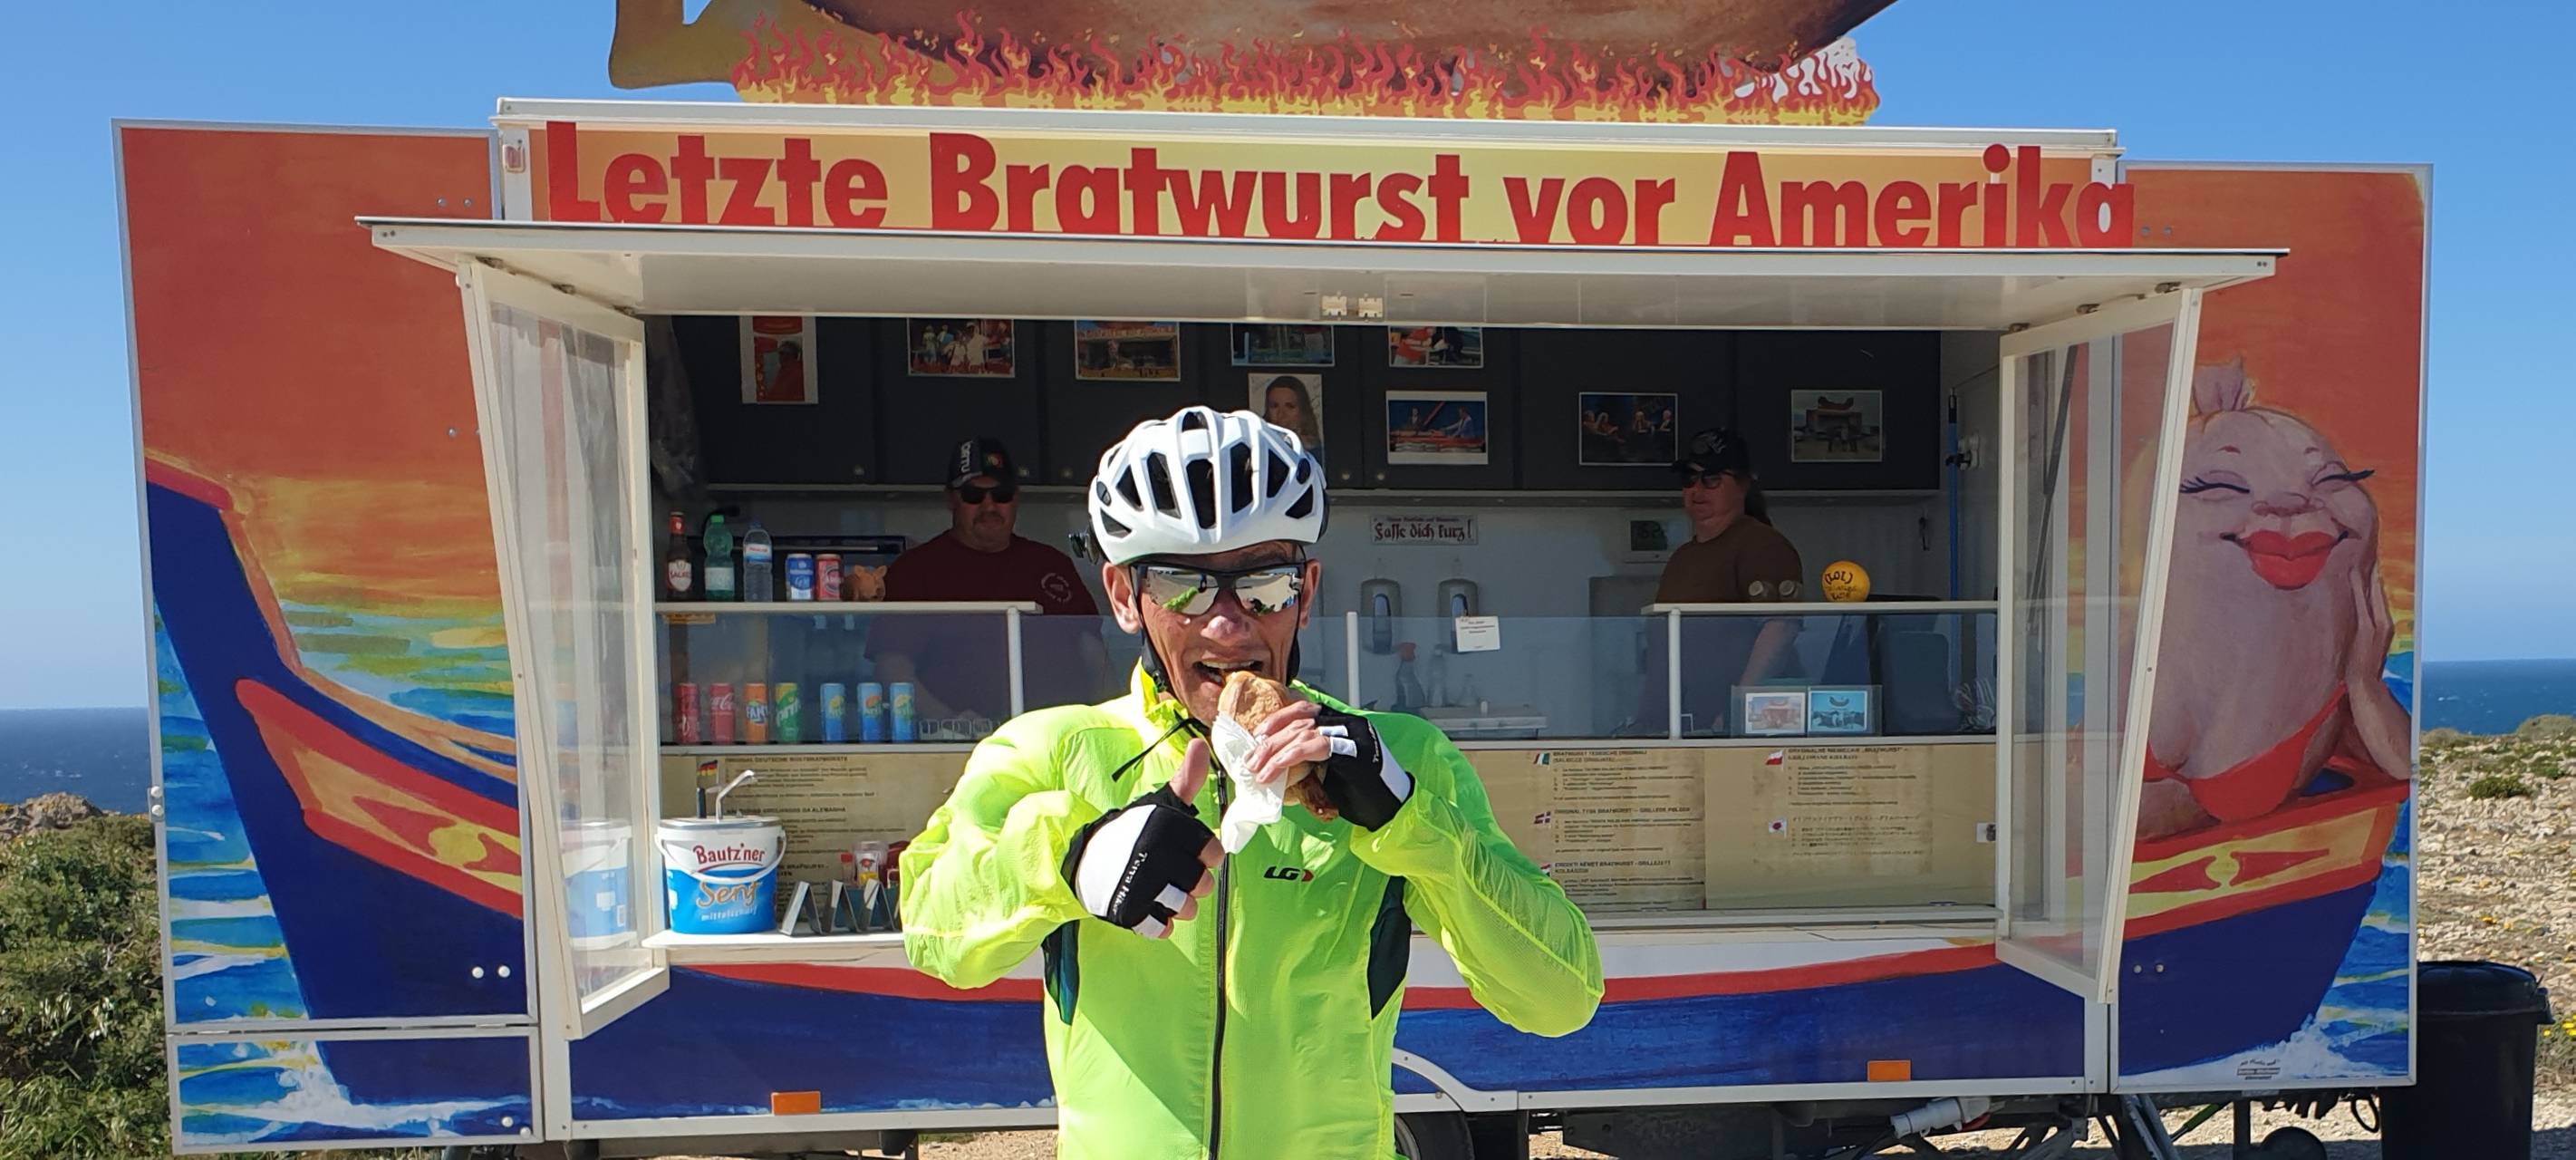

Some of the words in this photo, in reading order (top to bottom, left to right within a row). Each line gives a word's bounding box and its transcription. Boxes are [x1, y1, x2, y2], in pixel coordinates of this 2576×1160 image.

[546, 121, 888, 228] Letzte
[930, 132, 1470, 242] Bratwurst
[1502, 177, 1675, 246] vor
[1709, 143, 2136, 249] Amerika
[693, 843, 766, 865] Bautz'ner
